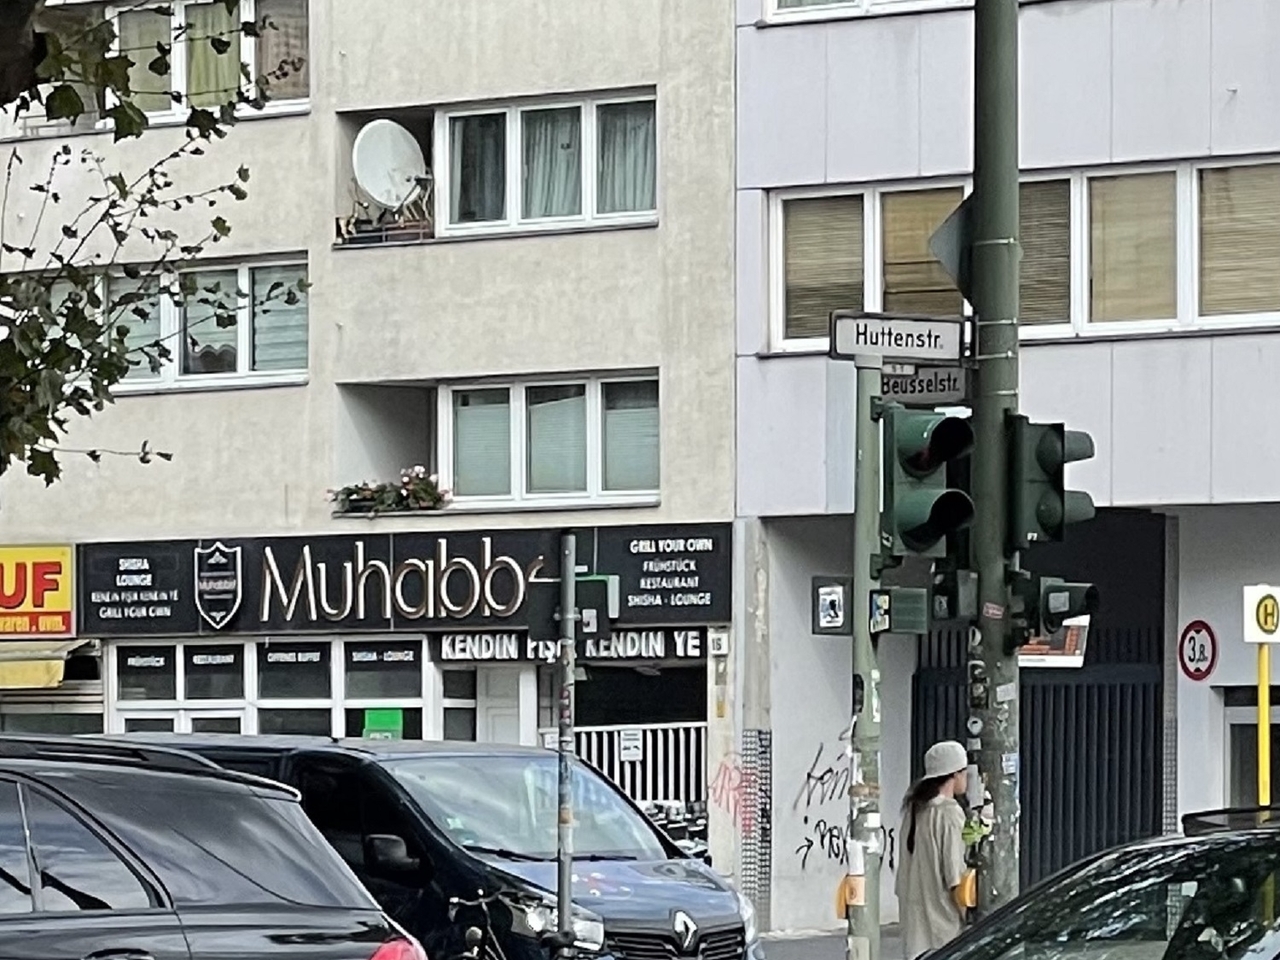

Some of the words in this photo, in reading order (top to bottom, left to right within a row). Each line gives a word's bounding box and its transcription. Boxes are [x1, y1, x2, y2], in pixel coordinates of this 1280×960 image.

[855, 323, 944, 349] Huttenstr.
[881, 371, 960, 396] Beusselstr.
[630, 539, 656, 553] GRILL
[658, 539, 685, 552] YOUR
[686, 538, 713, 551] OWN
[116, 574, 152, 587] LOUNGE
[670, 593, 711, 606] LOUNGE
[1264, 604, 1275, 626] H
[441, 634, 518, 660] KENDIN
[674, 631, 701, 657] YE
